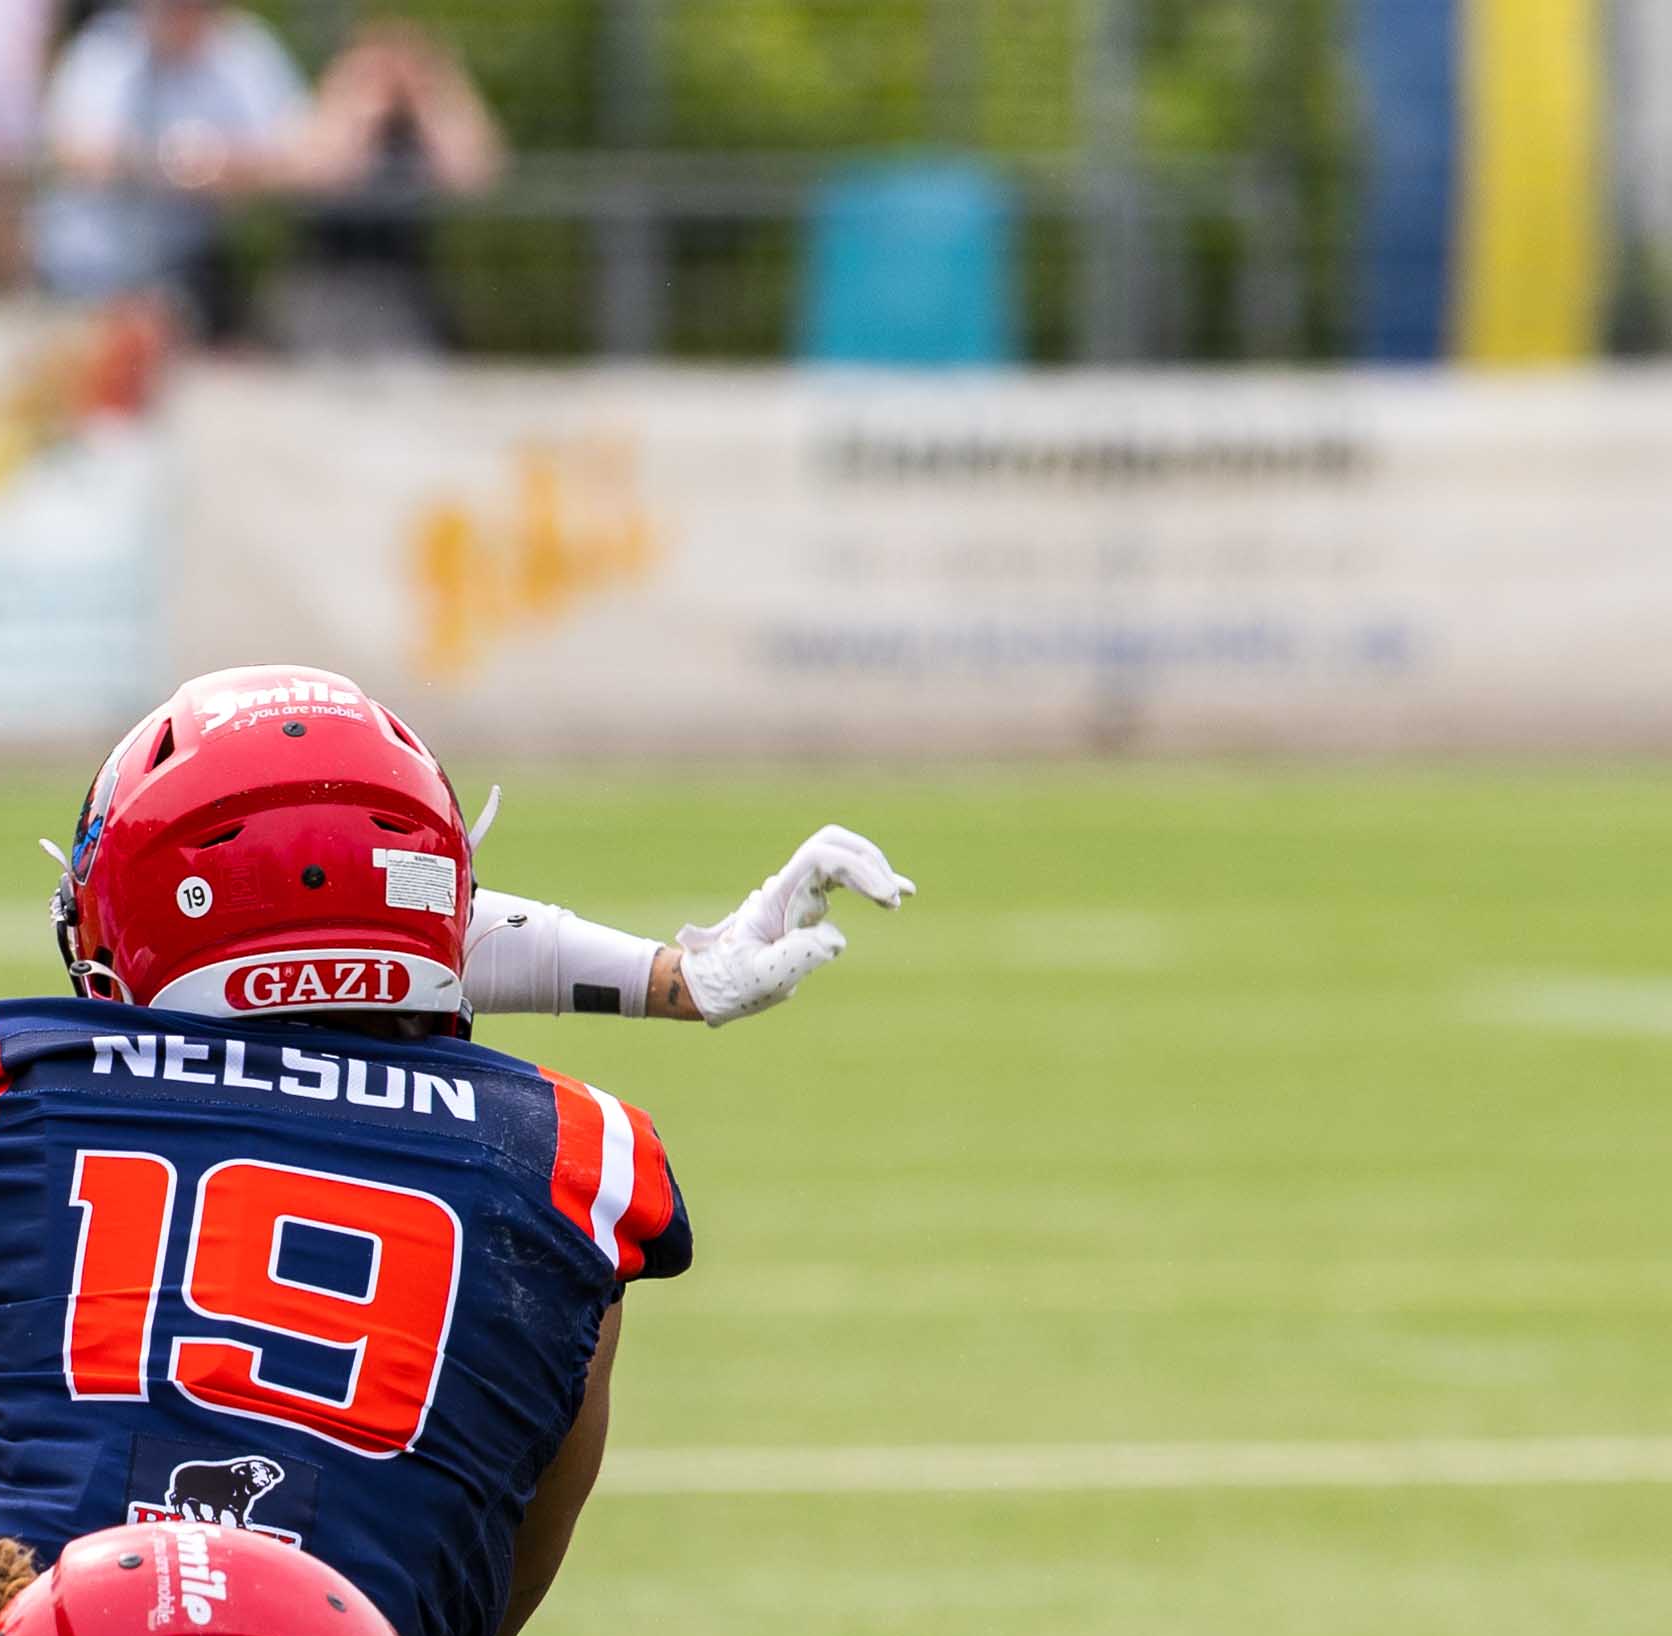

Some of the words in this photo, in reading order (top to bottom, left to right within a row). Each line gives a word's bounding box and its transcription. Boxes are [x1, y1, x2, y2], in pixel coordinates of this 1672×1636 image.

[281, 704, 309, 715] are
[183, 886, 206, 909] 19
[92, 1033, 477, 1122] NELSON
[62, 1148, 464, 1460] 19
